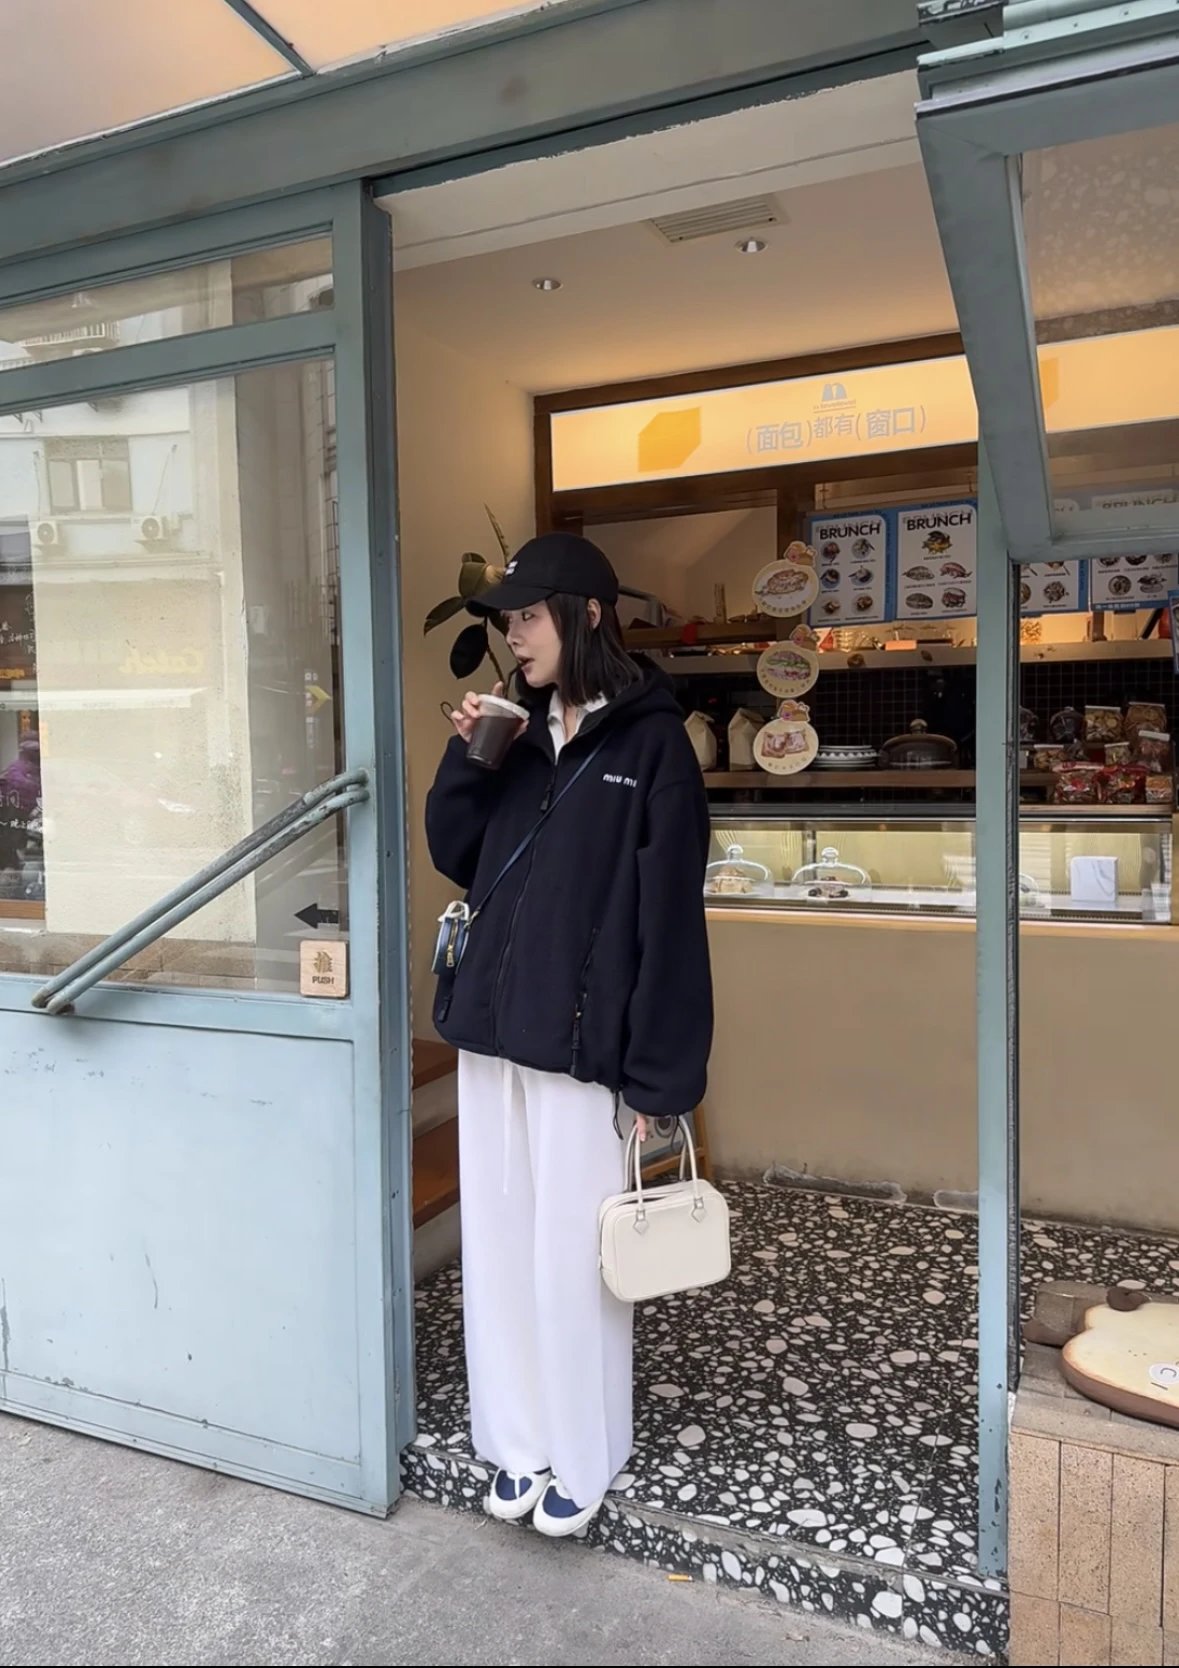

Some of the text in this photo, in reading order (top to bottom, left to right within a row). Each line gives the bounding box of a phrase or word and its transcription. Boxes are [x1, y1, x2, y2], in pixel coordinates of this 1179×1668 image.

[907, 513, 971, 530] BRUNCH
[820, 523, 880, 540] BRUNCH
[603, 773, 638, 787] miu mi
[311, 975, 335, 985] PUSH
